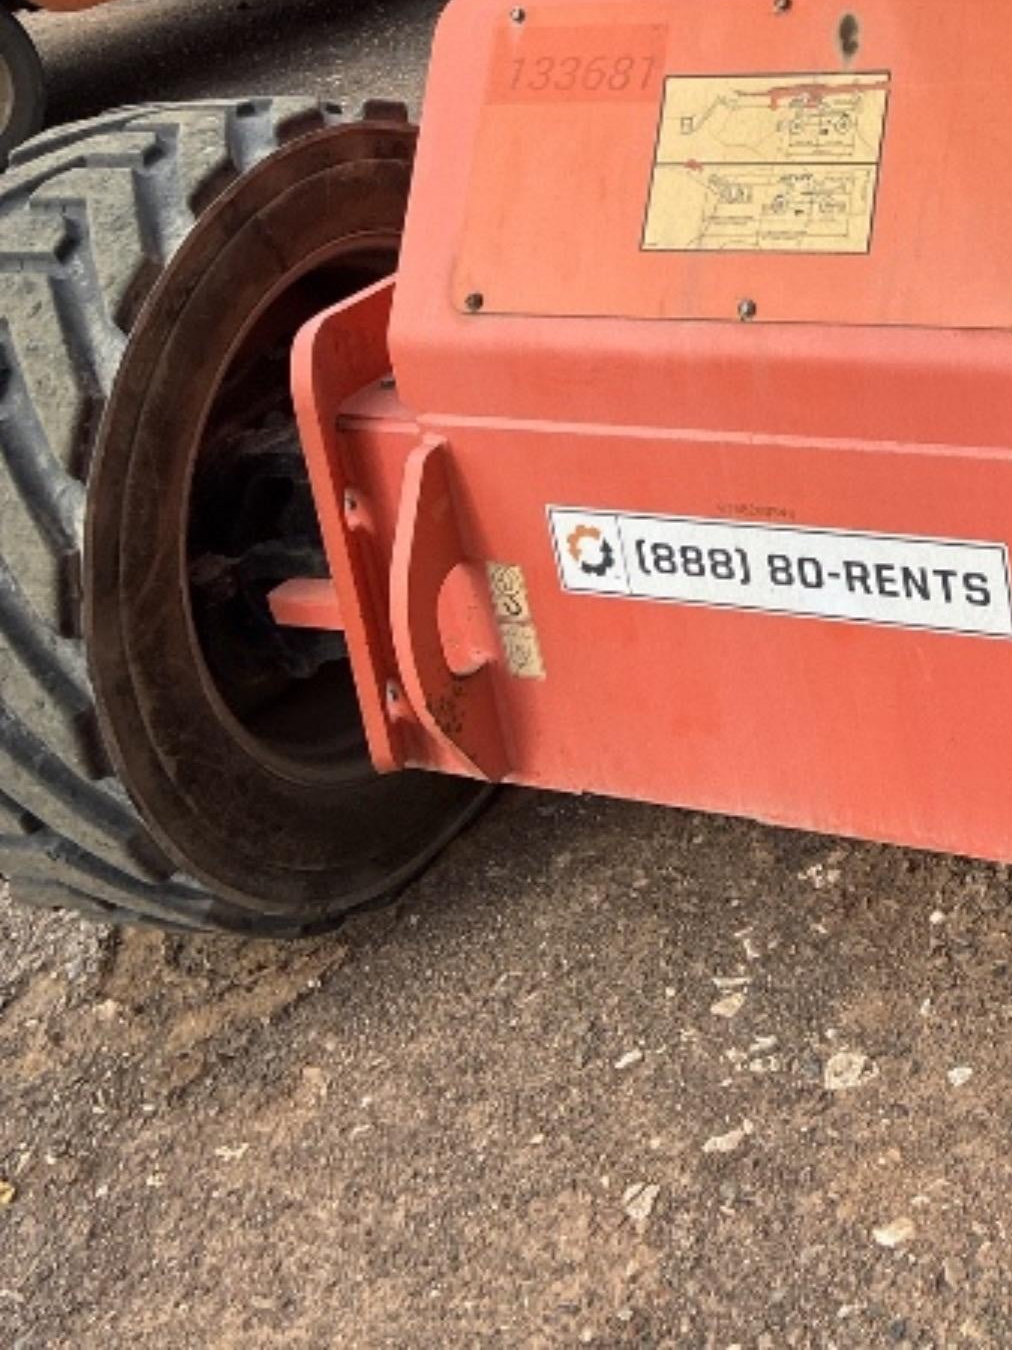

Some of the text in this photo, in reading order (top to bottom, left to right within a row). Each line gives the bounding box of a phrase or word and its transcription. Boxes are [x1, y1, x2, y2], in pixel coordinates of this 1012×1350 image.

[510, 56, 655, 91] 133681
[634, 539, 992, 607] (888) 80-RENTS
